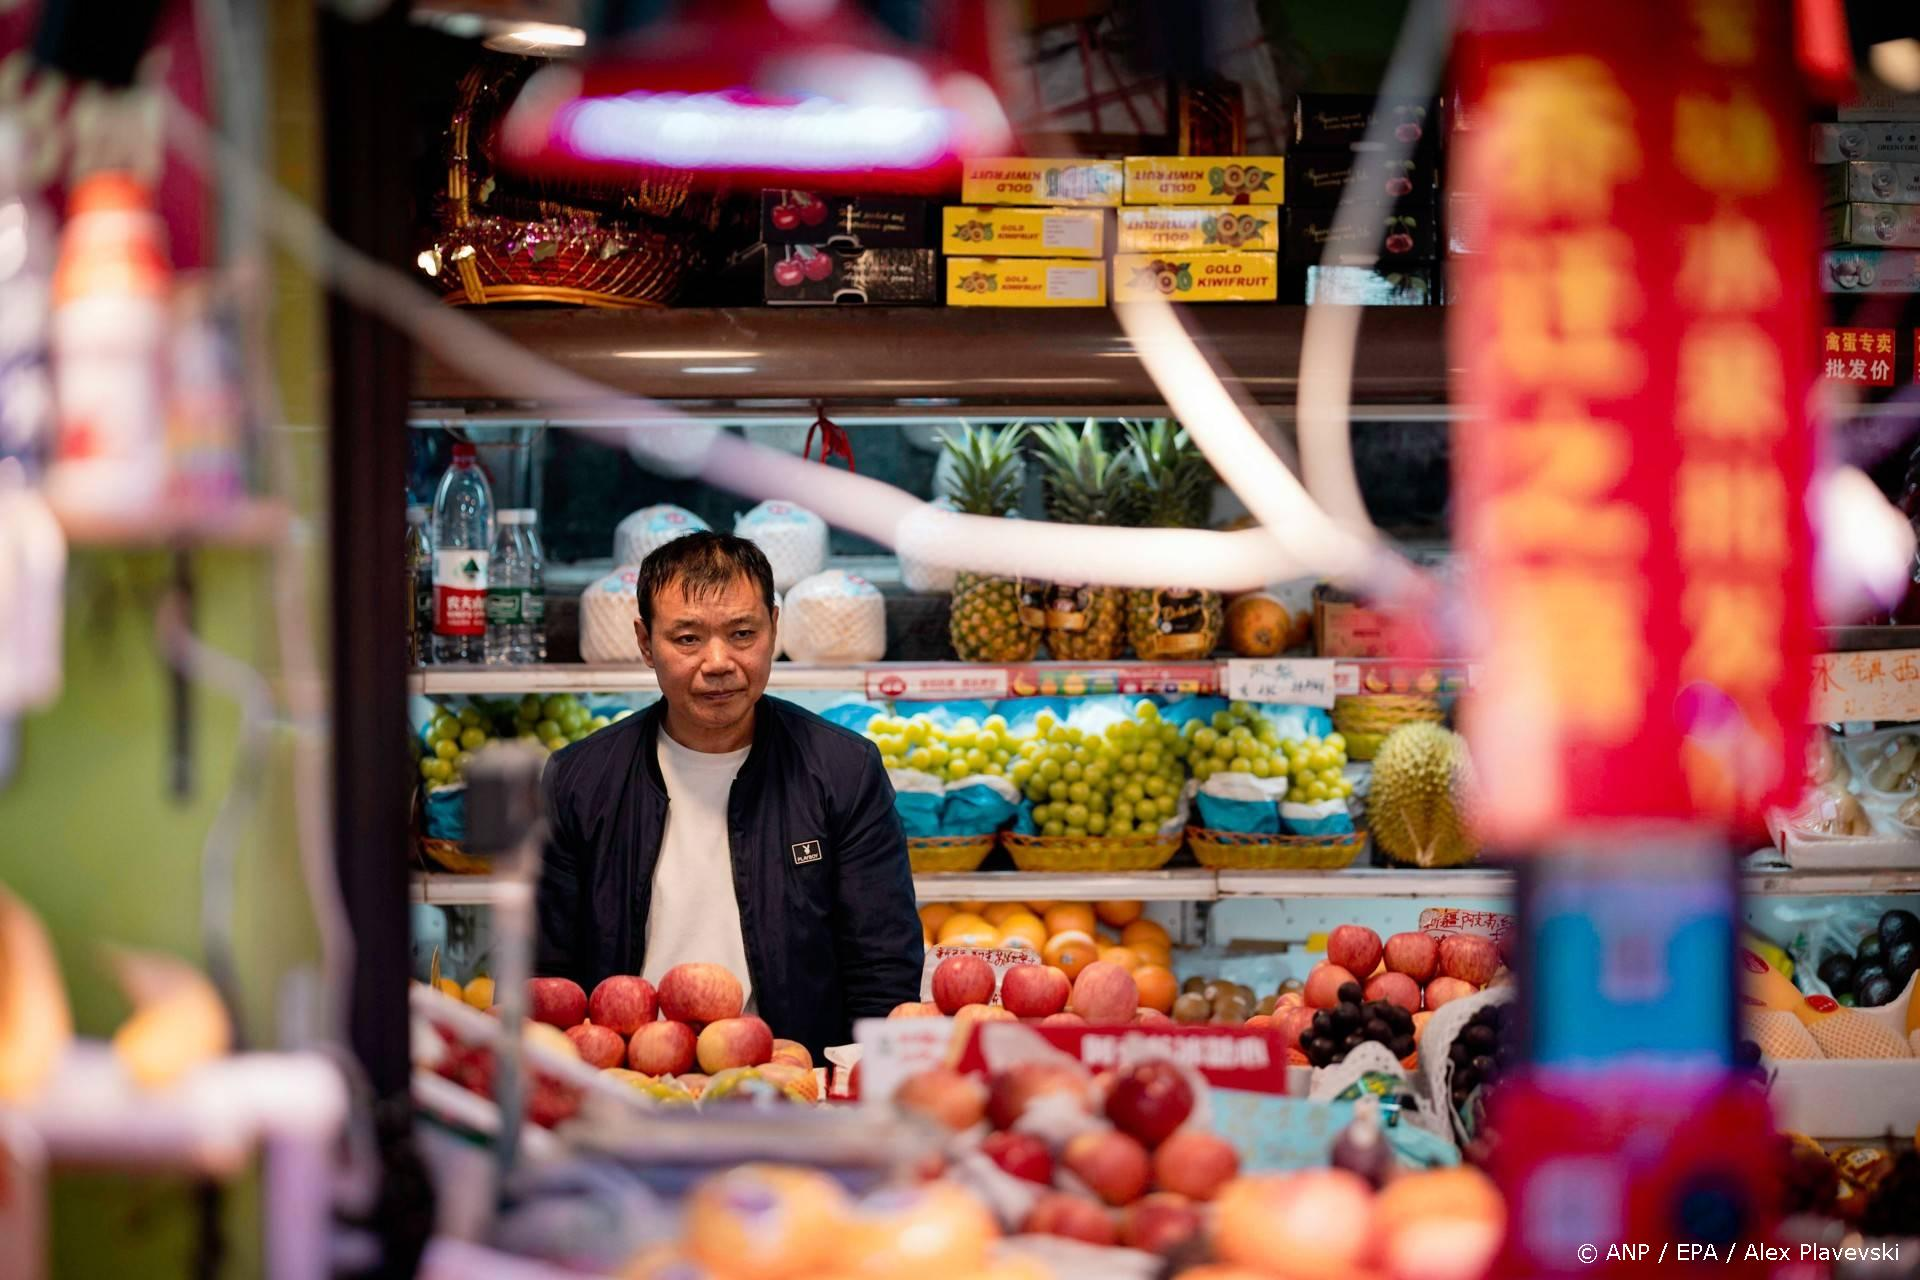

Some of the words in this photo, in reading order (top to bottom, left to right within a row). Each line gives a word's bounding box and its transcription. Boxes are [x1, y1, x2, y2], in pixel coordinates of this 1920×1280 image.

[1135, 170, 1204, 181] KIWIFRUIT
[996, 183, 1033, 193] GOLD
[1159, 183, 1196, 193] GOLD
[1205, 264, 1243, 275] GOLD
[1005, 275, 1029, 283] GOLD
[1197, 276, 1270, 288] KIWIFRUIT
[1825, 331, 1892, 353] 禽蛋专卖
[1825, 358, 1890, 380] 批发价
